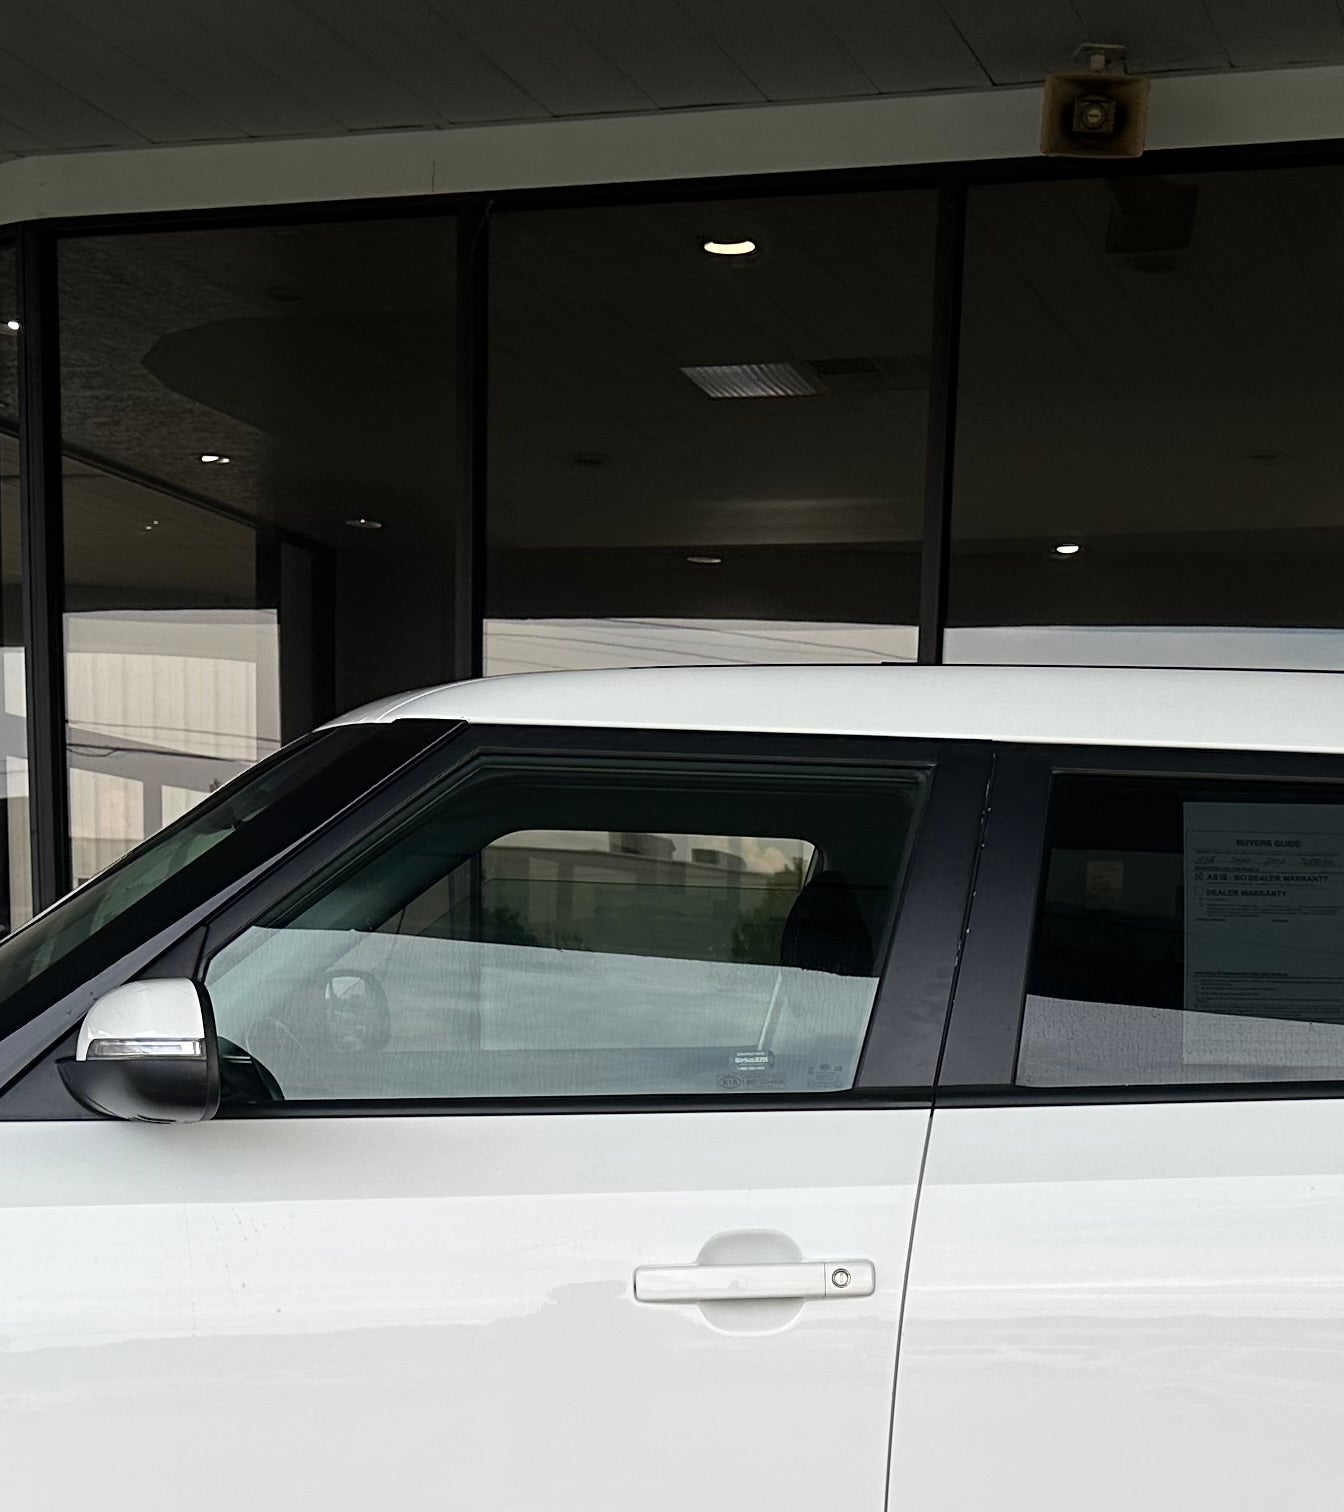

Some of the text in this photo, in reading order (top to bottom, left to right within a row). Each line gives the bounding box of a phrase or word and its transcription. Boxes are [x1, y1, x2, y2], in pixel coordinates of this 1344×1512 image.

[1236, 839, 1302, 849] BUYERS GUIDE
[1248, 874, 1281, 882] DEALER
[1283, 875, 1329, 883] WARRANTY
[1206, 888, 1286, 898] DEALER WARRANTY
